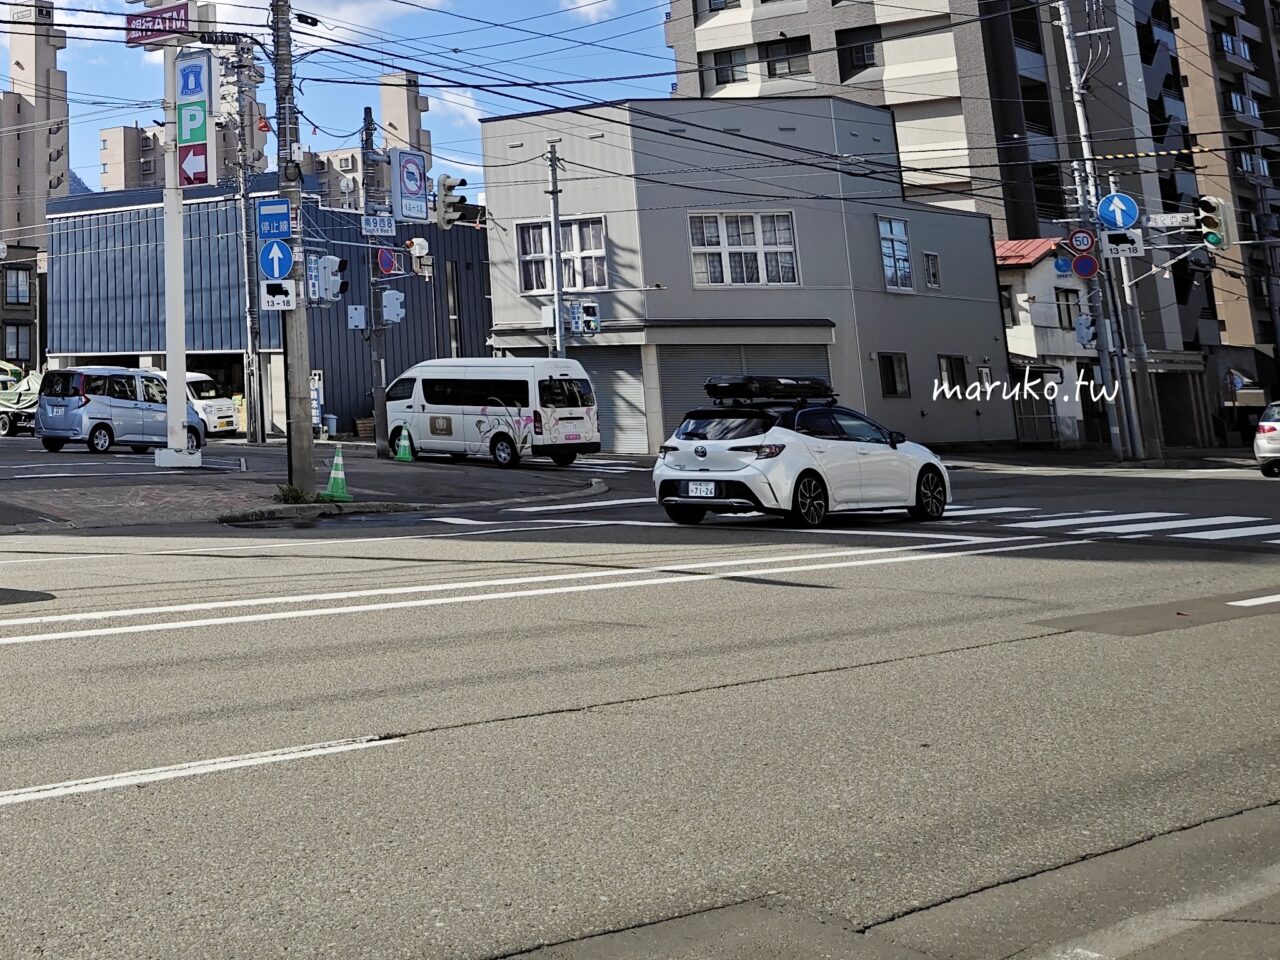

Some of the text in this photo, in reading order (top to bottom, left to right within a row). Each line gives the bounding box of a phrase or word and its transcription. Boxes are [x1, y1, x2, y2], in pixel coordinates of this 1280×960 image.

[130, 9, 186, 38] 銀行ATM
[181, 105, 205, 140] P
[260, 220, 289, 233] 停止線
[1074, 235, 1089, 247] 50
